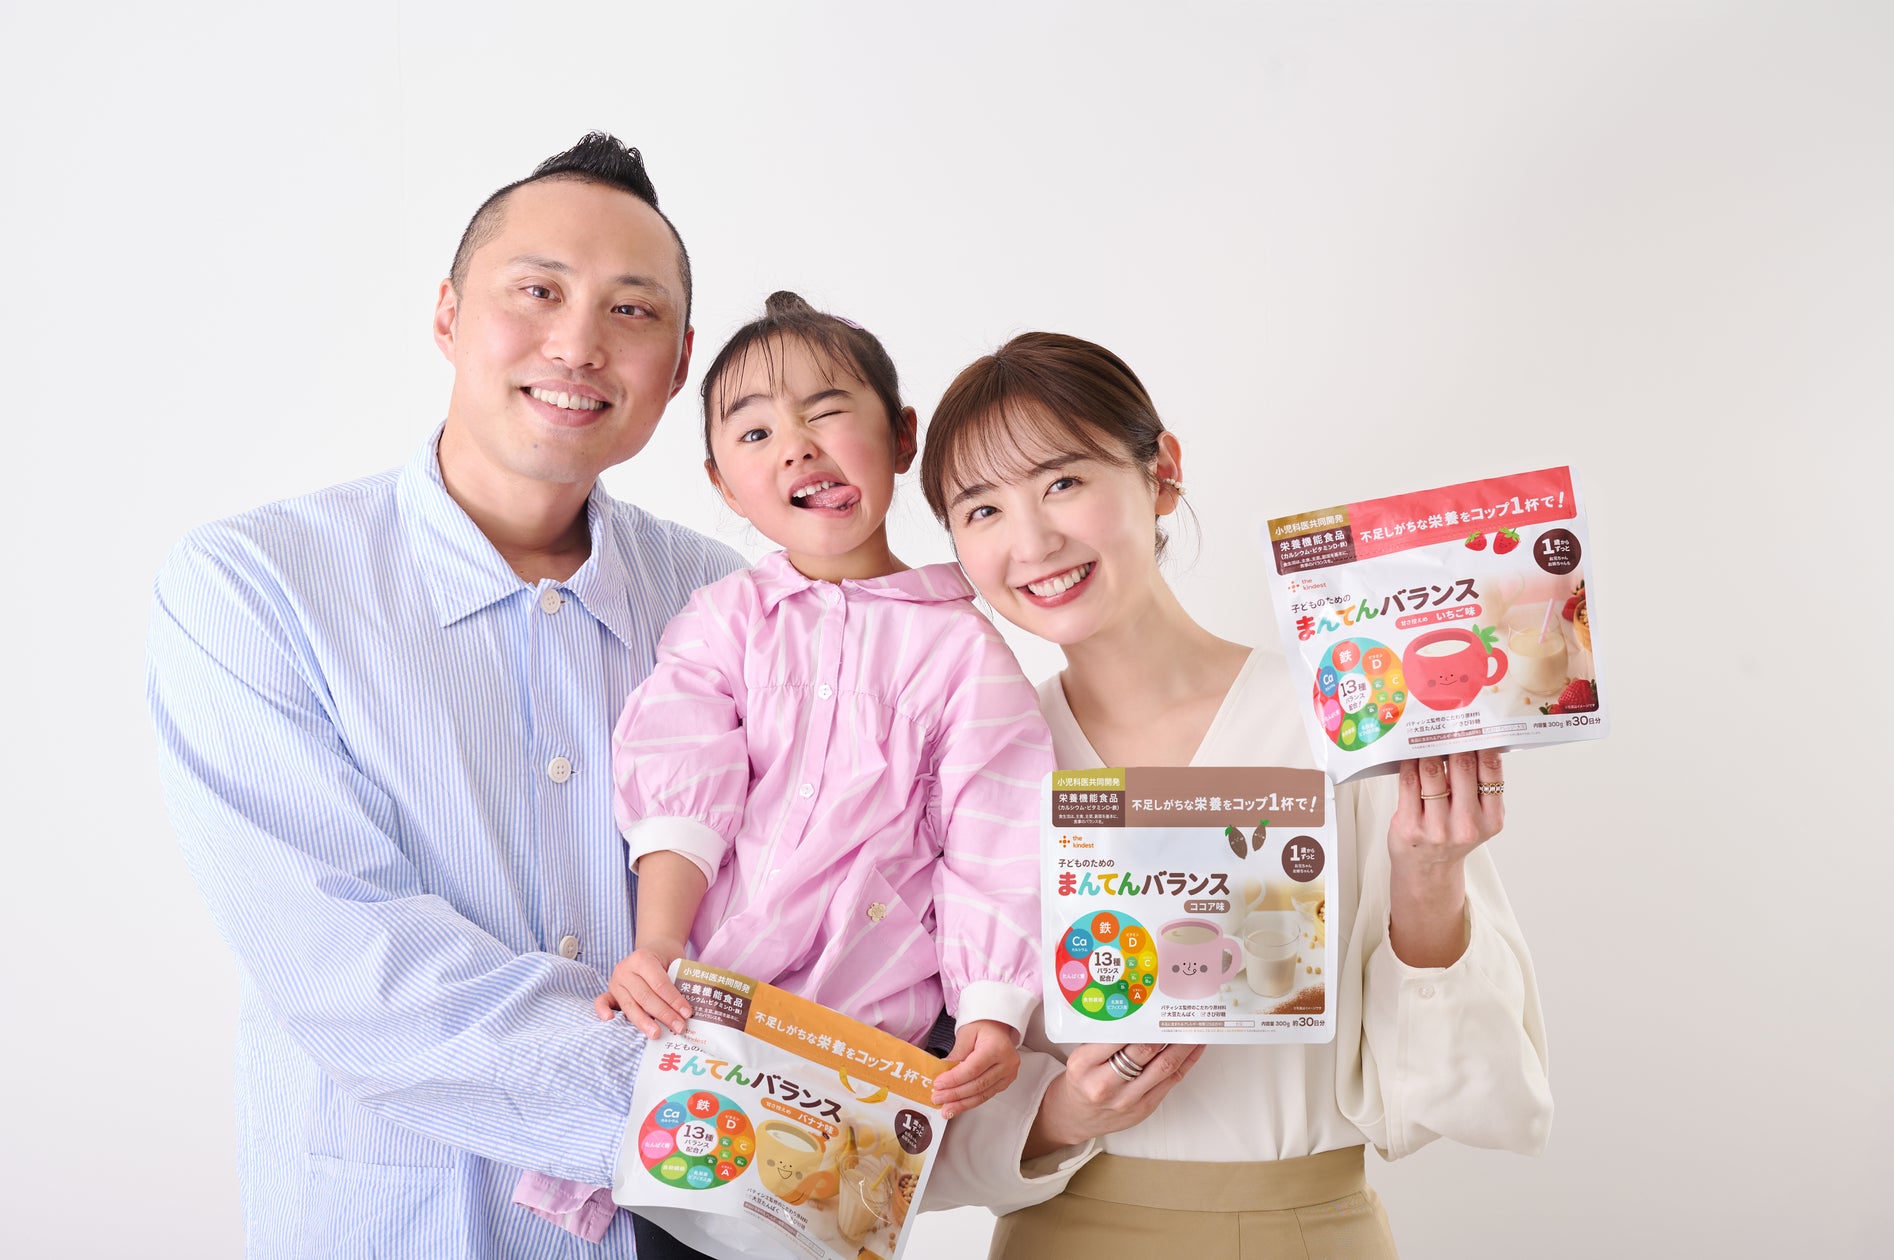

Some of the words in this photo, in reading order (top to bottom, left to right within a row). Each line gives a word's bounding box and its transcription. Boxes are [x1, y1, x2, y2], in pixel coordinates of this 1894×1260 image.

[1360, 491, 1564, 543] 不足しがちな栄養をコップ1杯で!
[1275, 514, 1344, 536] 小児科医共同開発
[1280, 530, 1345, 551] 栄養機能食品
[1291, 594, 1351, 613] 子どものための
[1296, 578, 1479, 641] まんてんバランス
[1436, 606, 1476, 621] いちご味
[1339, 650, 1352, 664] 鉄
[1372, 660, 1382, 669] D
[1323, 674, 1334, 685] Ca
[1392, 676, 1400, 685] C
[1385, 712, 1393, 720] A
[1566, 716, 1602, 727] 約30日分
[1058, 777, 1120, 787] 小児科医共同開発
[1059, 793, 1118, 803] 栄養機能食品
[1131, 793, 1317, 813] 不足しがちな栄養をコップ1杯で!
[1058, 859, 1115, 868] 子どものための
[1058, 870, 1230, 896] まんてんバランス
[1190, 902, 1225, 912] ココア味
[1099, 921, 1112, 934] 鉄
[1072, 936, 1087, 946] Ca
[1128, 937, 1137, 947] D
[1094, 952, 1121, 966] 13種
[1144, 959, 1151, 967] C
[683, 968, 750, 994] 小児科医共同開発
[681, 982, 743, 1008] 栄養機能食品
[1134, 992, 1141, 1000] A
[1292, 1017, 1325, 1027] 約30日分
[755, 1011, 935, 1092] 不足しがちな栄養をコップ1杯で
[658, 1053, 841, 1123] まんてんバランス
[696, 1099, 710, 1112] 鉄
[663, 1109, 680, 1118] Ca
[726, 1120, 736, 1129] D
[798, 1113, 834, 1134] バナナ味
[683, 1125, 714, 1142] 13種
[685, 1140, 710, 1148] バランス
[740, 1143, 747, 1151] C
